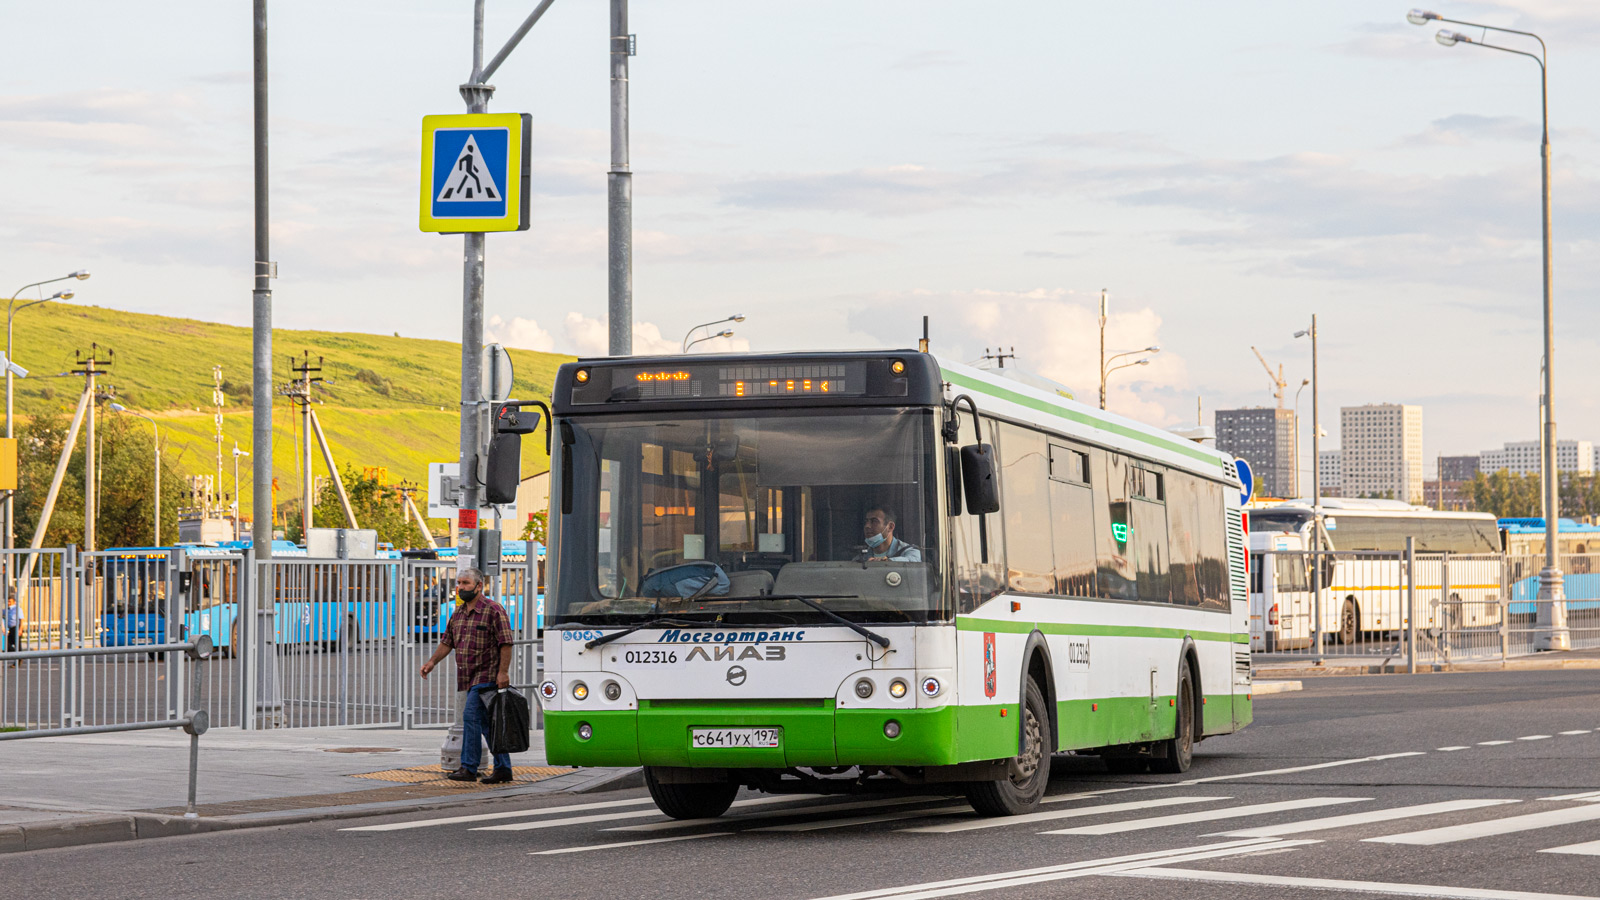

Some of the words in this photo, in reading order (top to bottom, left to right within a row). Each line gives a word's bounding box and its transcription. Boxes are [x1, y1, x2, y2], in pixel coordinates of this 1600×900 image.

[658, 629, 805, 645] Мосгортранс
[625, 650, 677, 664] 012316
[685, 646, 786, 661] ЛИАЗ
[1068, 642, 1088, 664] 012316
[754, 729, 775, 741] 197
